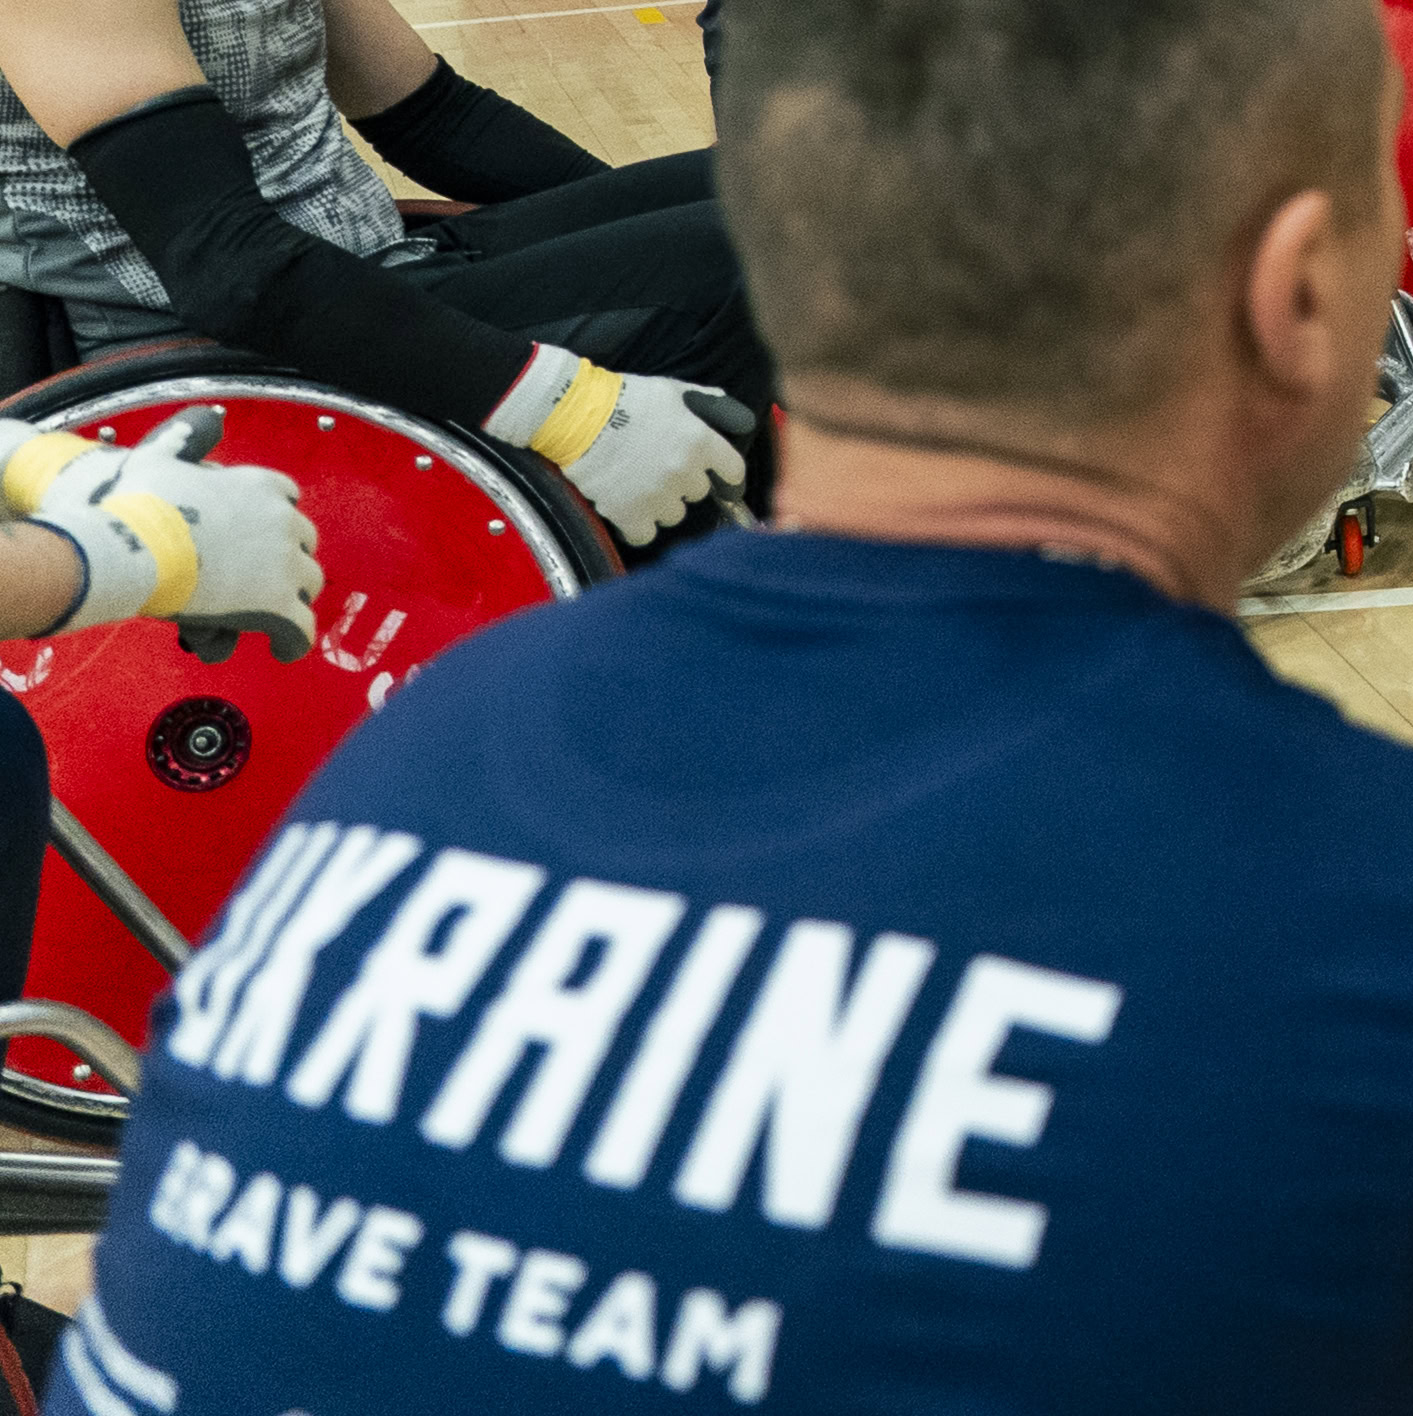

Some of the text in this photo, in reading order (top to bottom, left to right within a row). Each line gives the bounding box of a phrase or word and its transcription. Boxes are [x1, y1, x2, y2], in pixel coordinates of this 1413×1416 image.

[168, 821, 1125, 1272] UKRAINE
[150, 1140, 784, 1406] BRAVE TEAM
